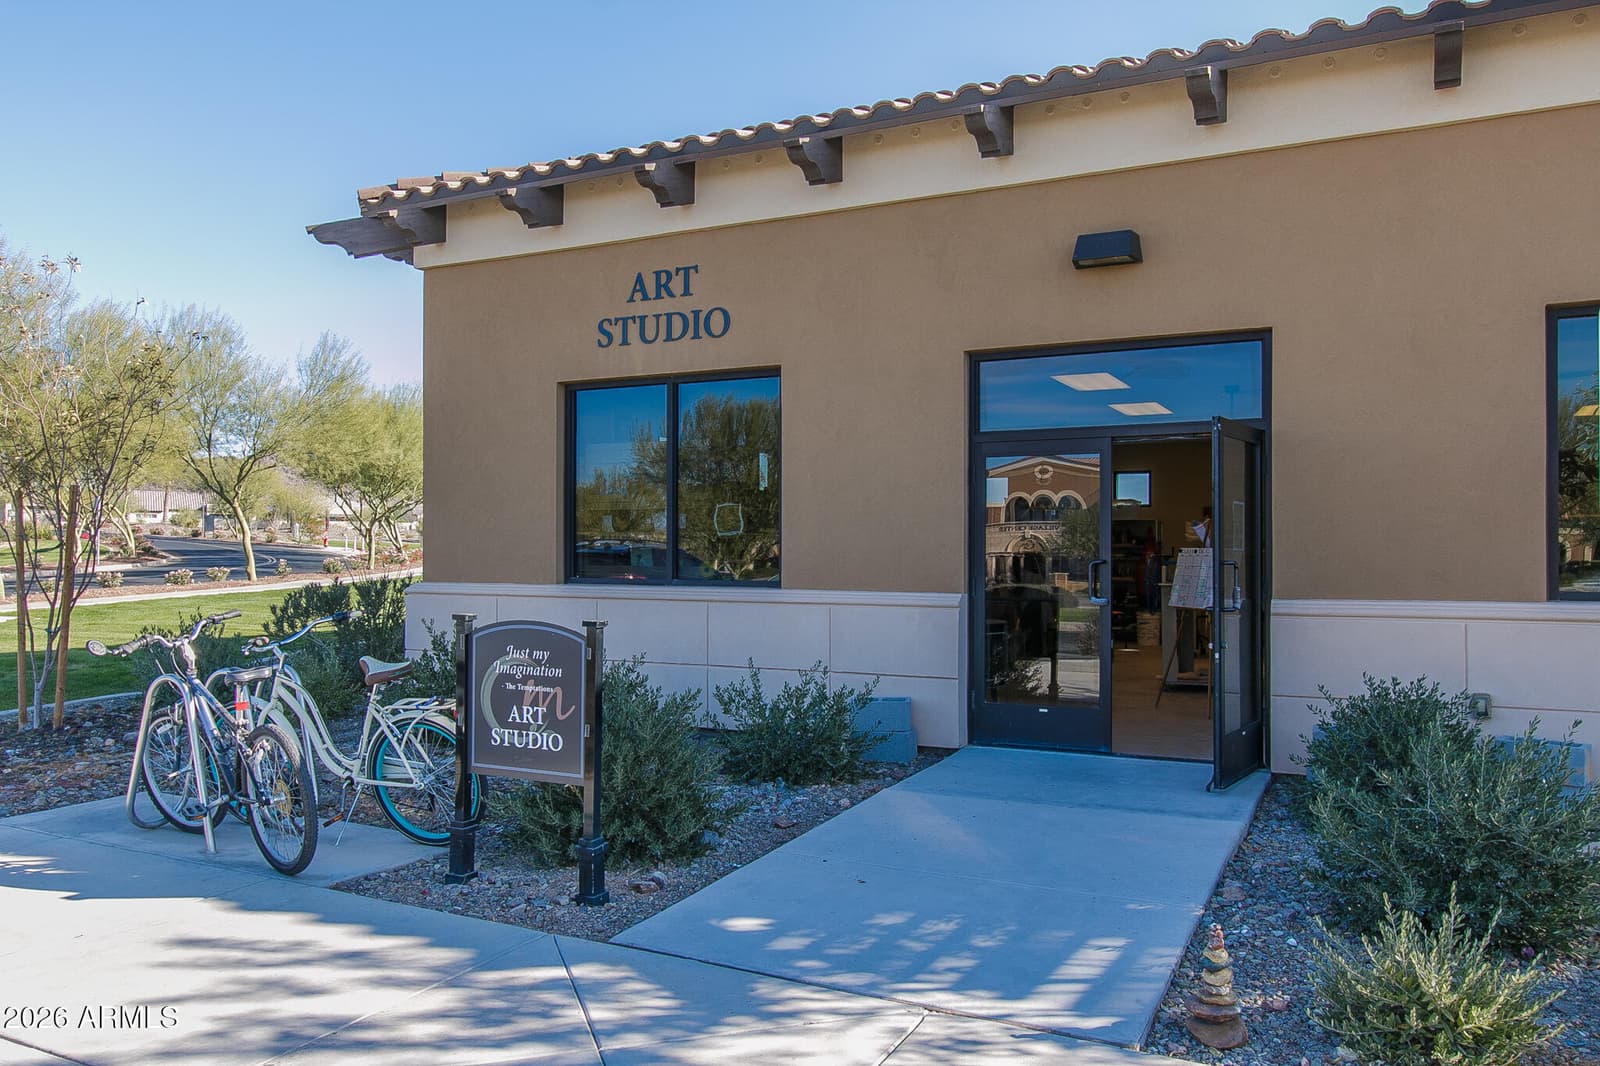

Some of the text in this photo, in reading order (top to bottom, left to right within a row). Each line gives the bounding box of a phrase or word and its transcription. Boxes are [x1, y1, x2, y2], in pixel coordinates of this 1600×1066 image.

[626, 264, 699, 303] ART
[597, 306, 731, 348] STUDIO
[506, 645, 550, 664] Just my
[493, 660, 562, 679] Imagination
[505, 682, 516, 690] The
[517, 683, 553, 693] Temptations
[507, 704, 547, 725] ART
[490, 727, 563, 752] STUDIO
